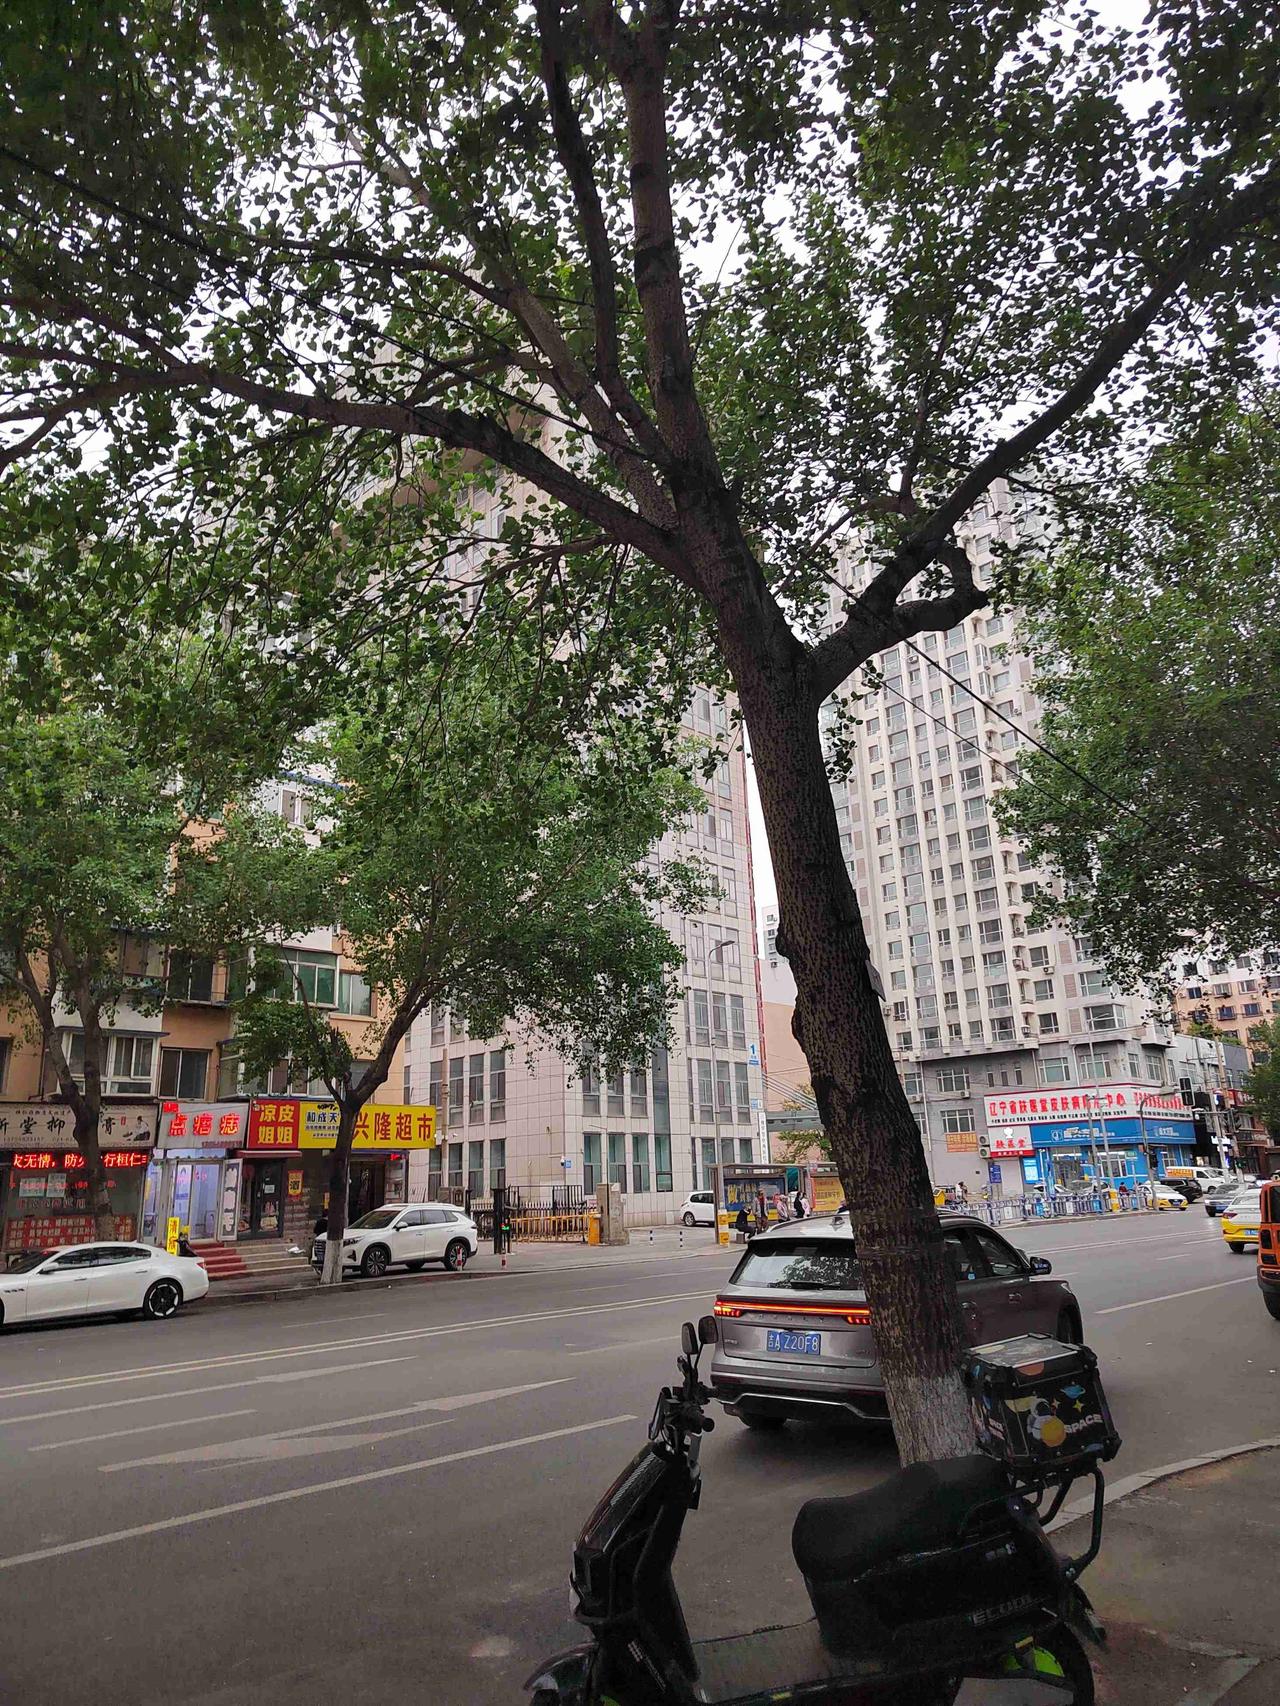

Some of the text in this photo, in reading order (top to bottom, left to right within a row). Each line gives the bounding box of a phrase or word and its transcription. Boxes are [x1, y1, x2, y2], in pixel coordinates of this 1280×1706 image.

[259, 1104, 294, 1123] 凉皮
[306, 1112, 341, 1123] 和成天
[258, 1126, 293, 1144] 姐姐
[352, 1112, 433, 1141] 兴隆超市
[1064, 1413, 1103, 1434] SPACE
